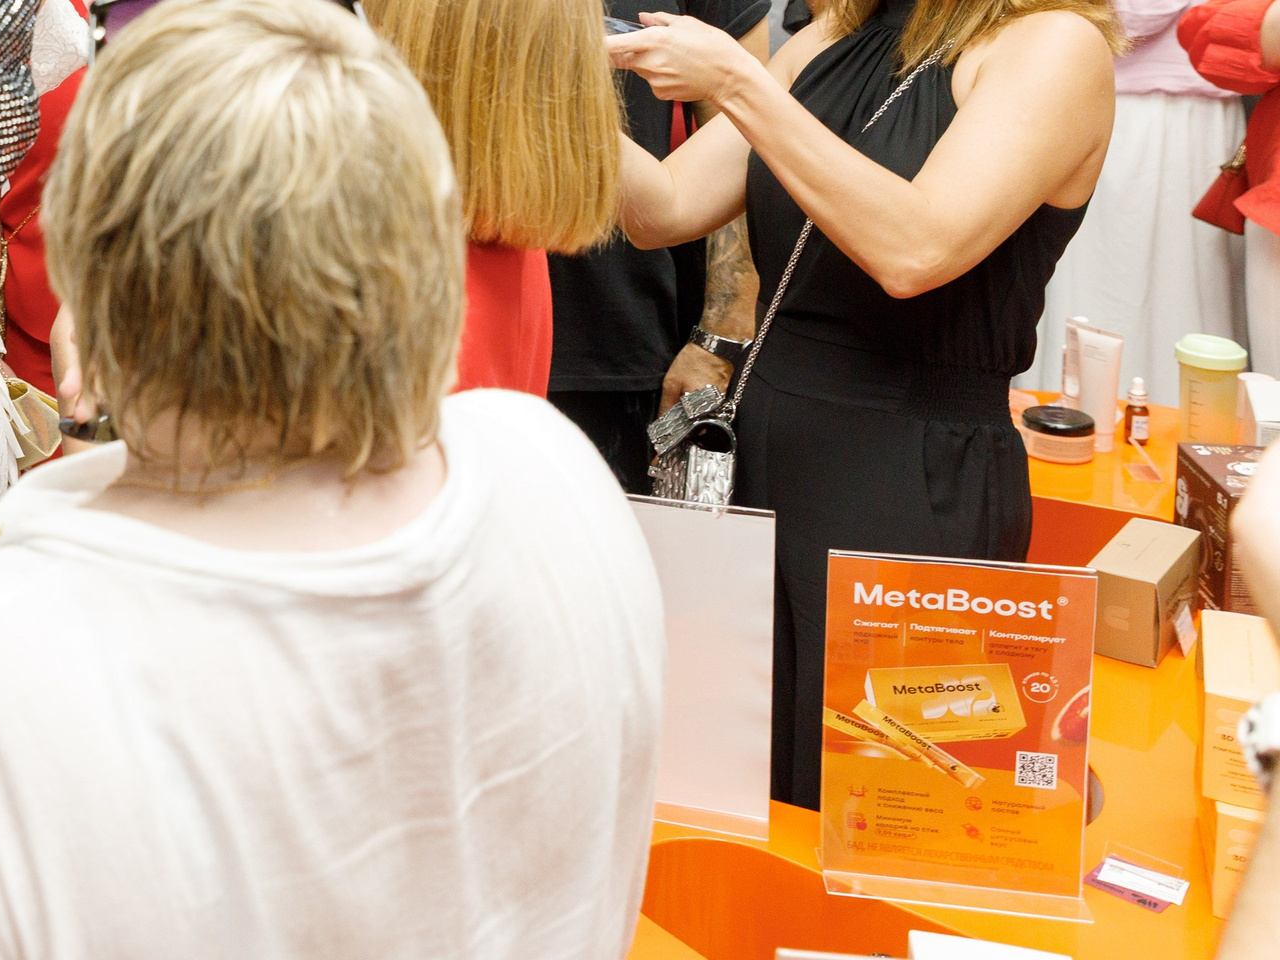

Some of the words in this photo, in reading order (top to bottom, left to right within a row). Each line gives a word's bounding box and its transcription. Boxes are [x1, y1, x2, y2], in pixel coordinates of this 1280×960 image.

[853, 618, 899, 629] Сжигает
[909, 623, 977, 636] Подтягивает
[909, 635, 943, 644] контуры
[989, 630, 1066, 645] Контролирует
[892, 682, 981, 696] MetaBoost
[1030, 682, 1051, 693] 20
[835, 713, 890, 740] MetaBoost
[882, 715, 932, 751] MetaBoost
